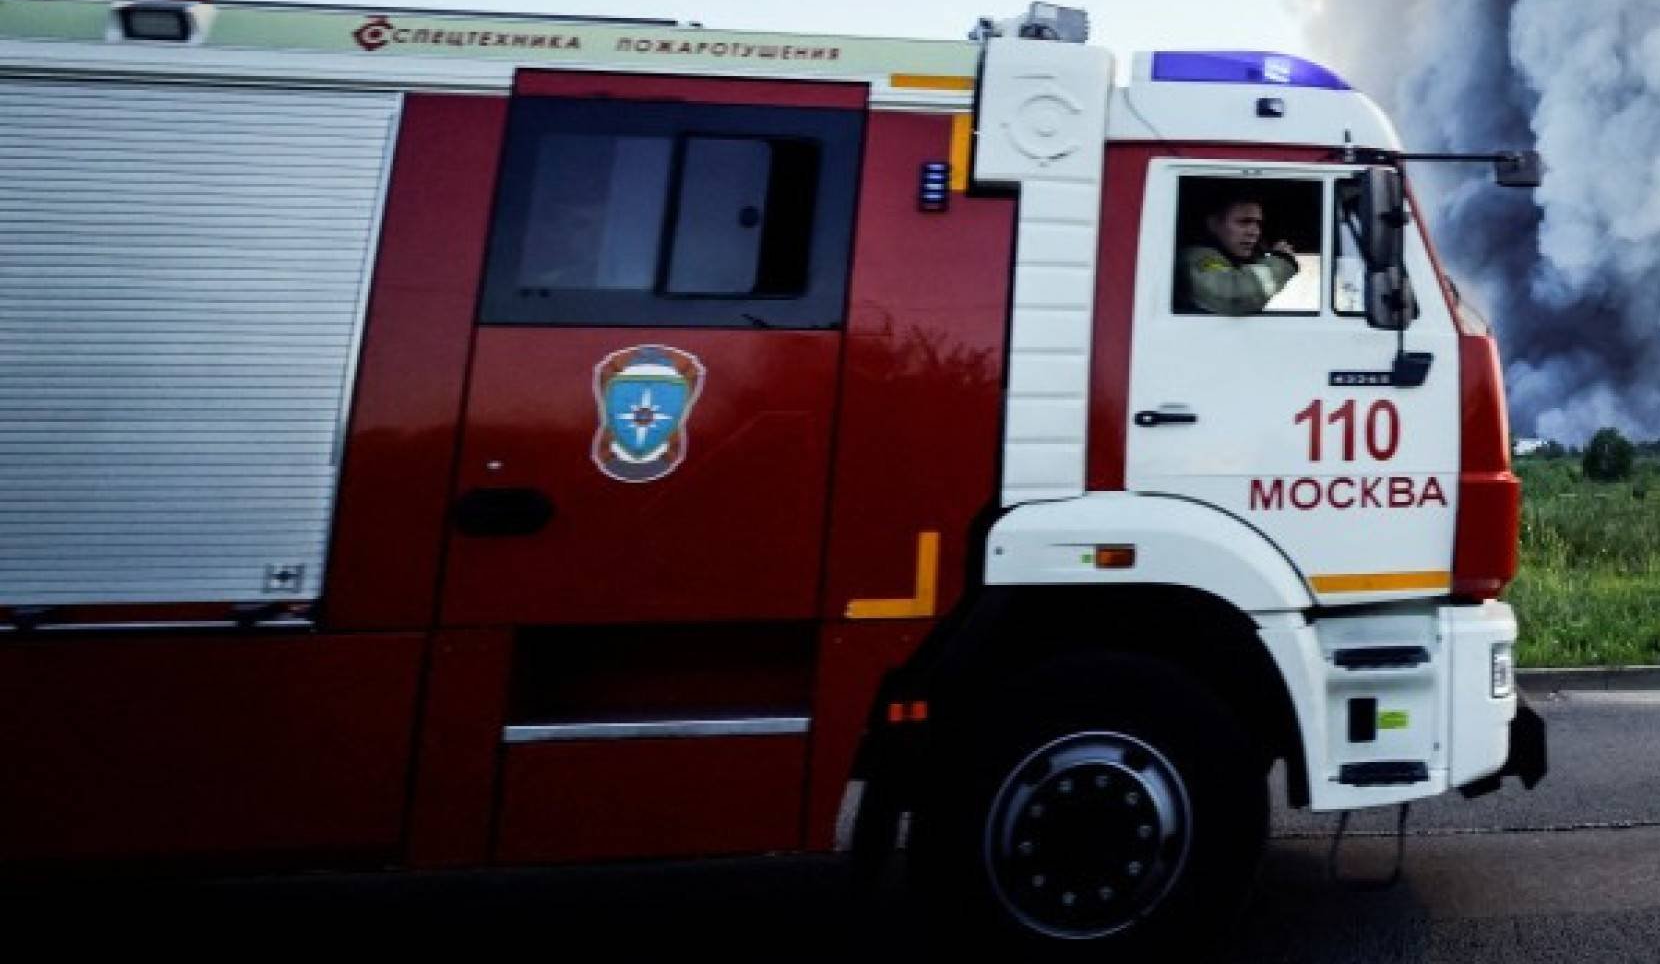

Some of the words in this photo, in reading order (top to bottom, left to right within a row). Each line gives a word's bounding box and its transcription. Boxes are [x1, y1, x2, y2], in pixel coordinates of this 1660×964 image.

[616, 36, 841, 61] ПОЖАРОТУШЕНИЯ
[1294, 399, 1400, 461] 110
[1250, 476, 1448, 510] МОСКВА
